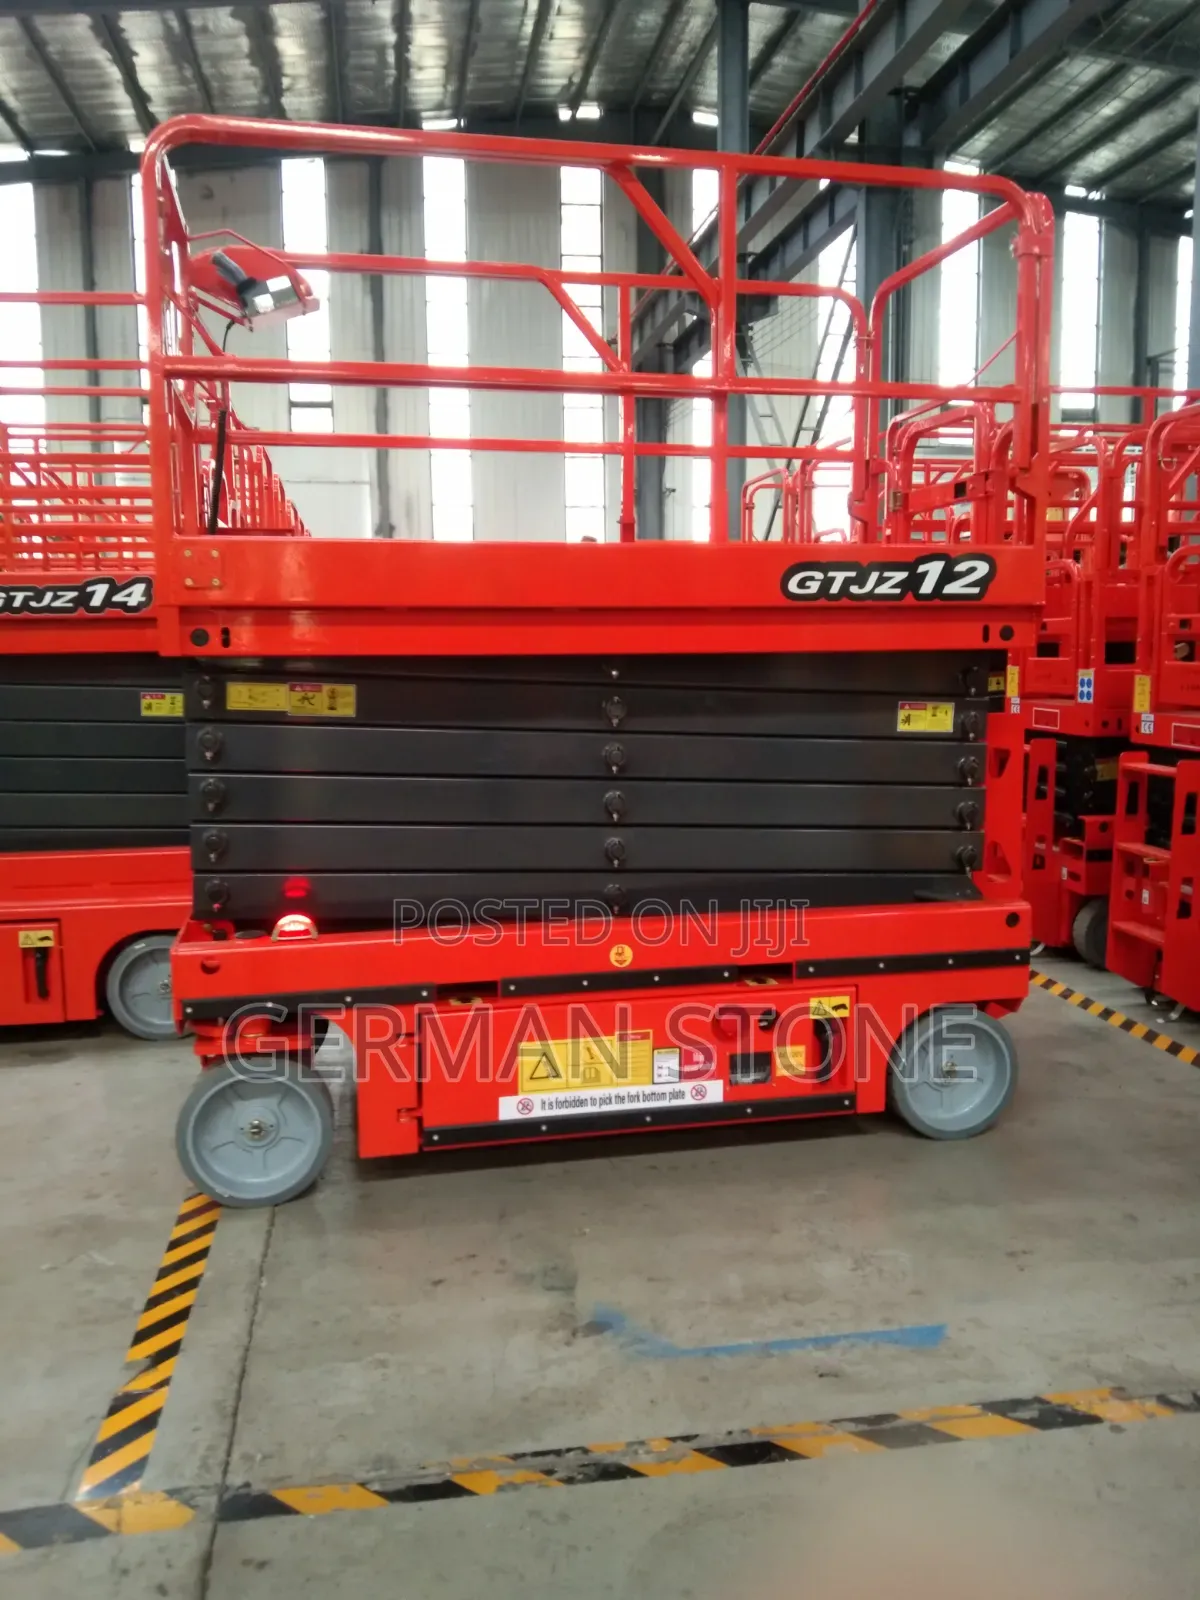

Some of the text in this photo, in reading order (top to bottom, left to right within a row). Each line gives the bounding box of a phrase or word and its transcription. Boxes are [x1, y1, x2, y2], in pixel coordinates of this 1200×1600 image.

[0, 583, 147, 608] TJZ14
[541, 1087, 686, 1111] It is forbidden to pick the fork bottom plate
